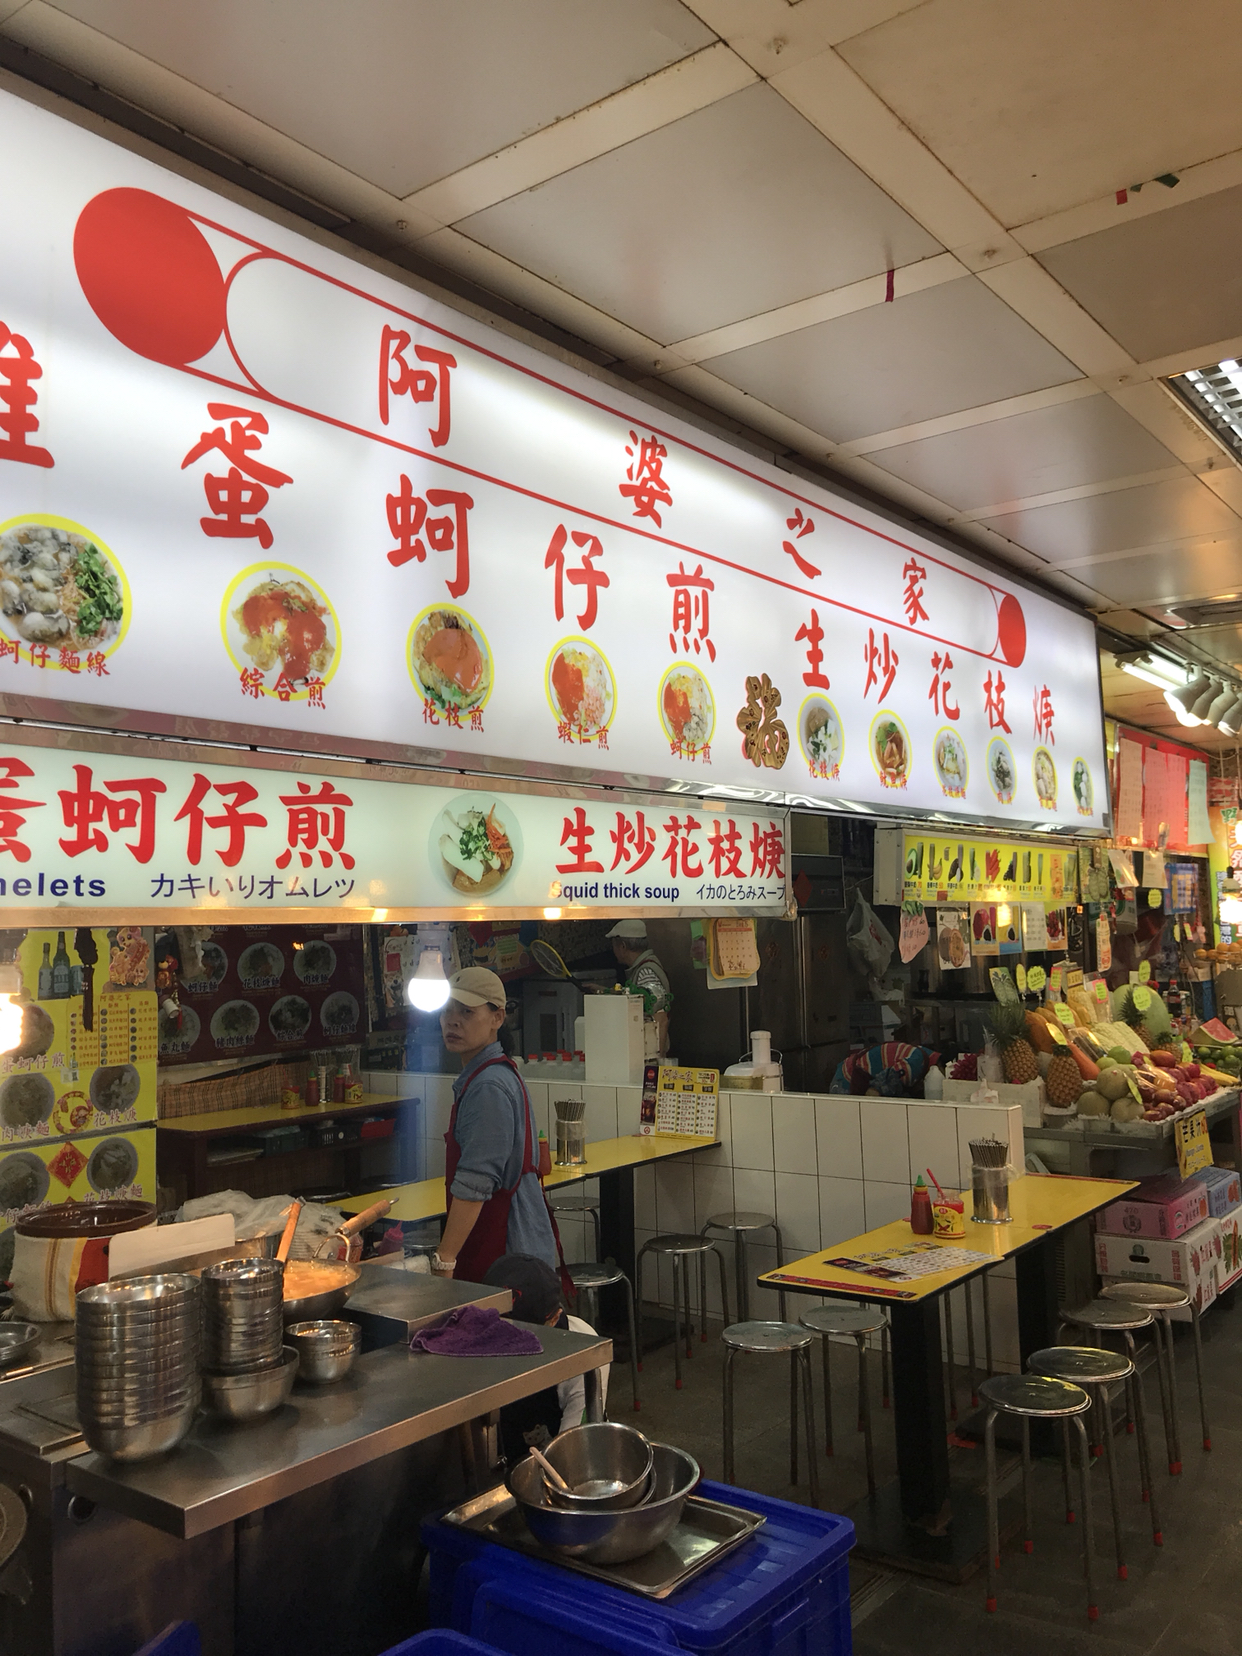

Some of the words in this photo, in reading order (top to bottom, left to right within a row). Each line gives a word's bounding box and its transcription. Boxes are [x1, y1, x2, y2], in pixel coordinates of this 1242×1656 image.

[379, 324, 929, 626] 阿婆之家
[0, 638, 110, 677] 蚵仔麵線
[239, 666, 326, 709] 綜合煎
[421, 697, 484, 732] 花枝煎
[558, 721, 609, 750] 蝦仁煎
[670, 739, 712, 765] 蚵仔煎
[555, 807, 786, 879] 生炒花枝焿
[0, 873, 106, 897] elets
[150, 872, 355, 899] カキいりオムレツ
[603, 882, 640, 899] thick
[644, 885, 680, 902] soup
